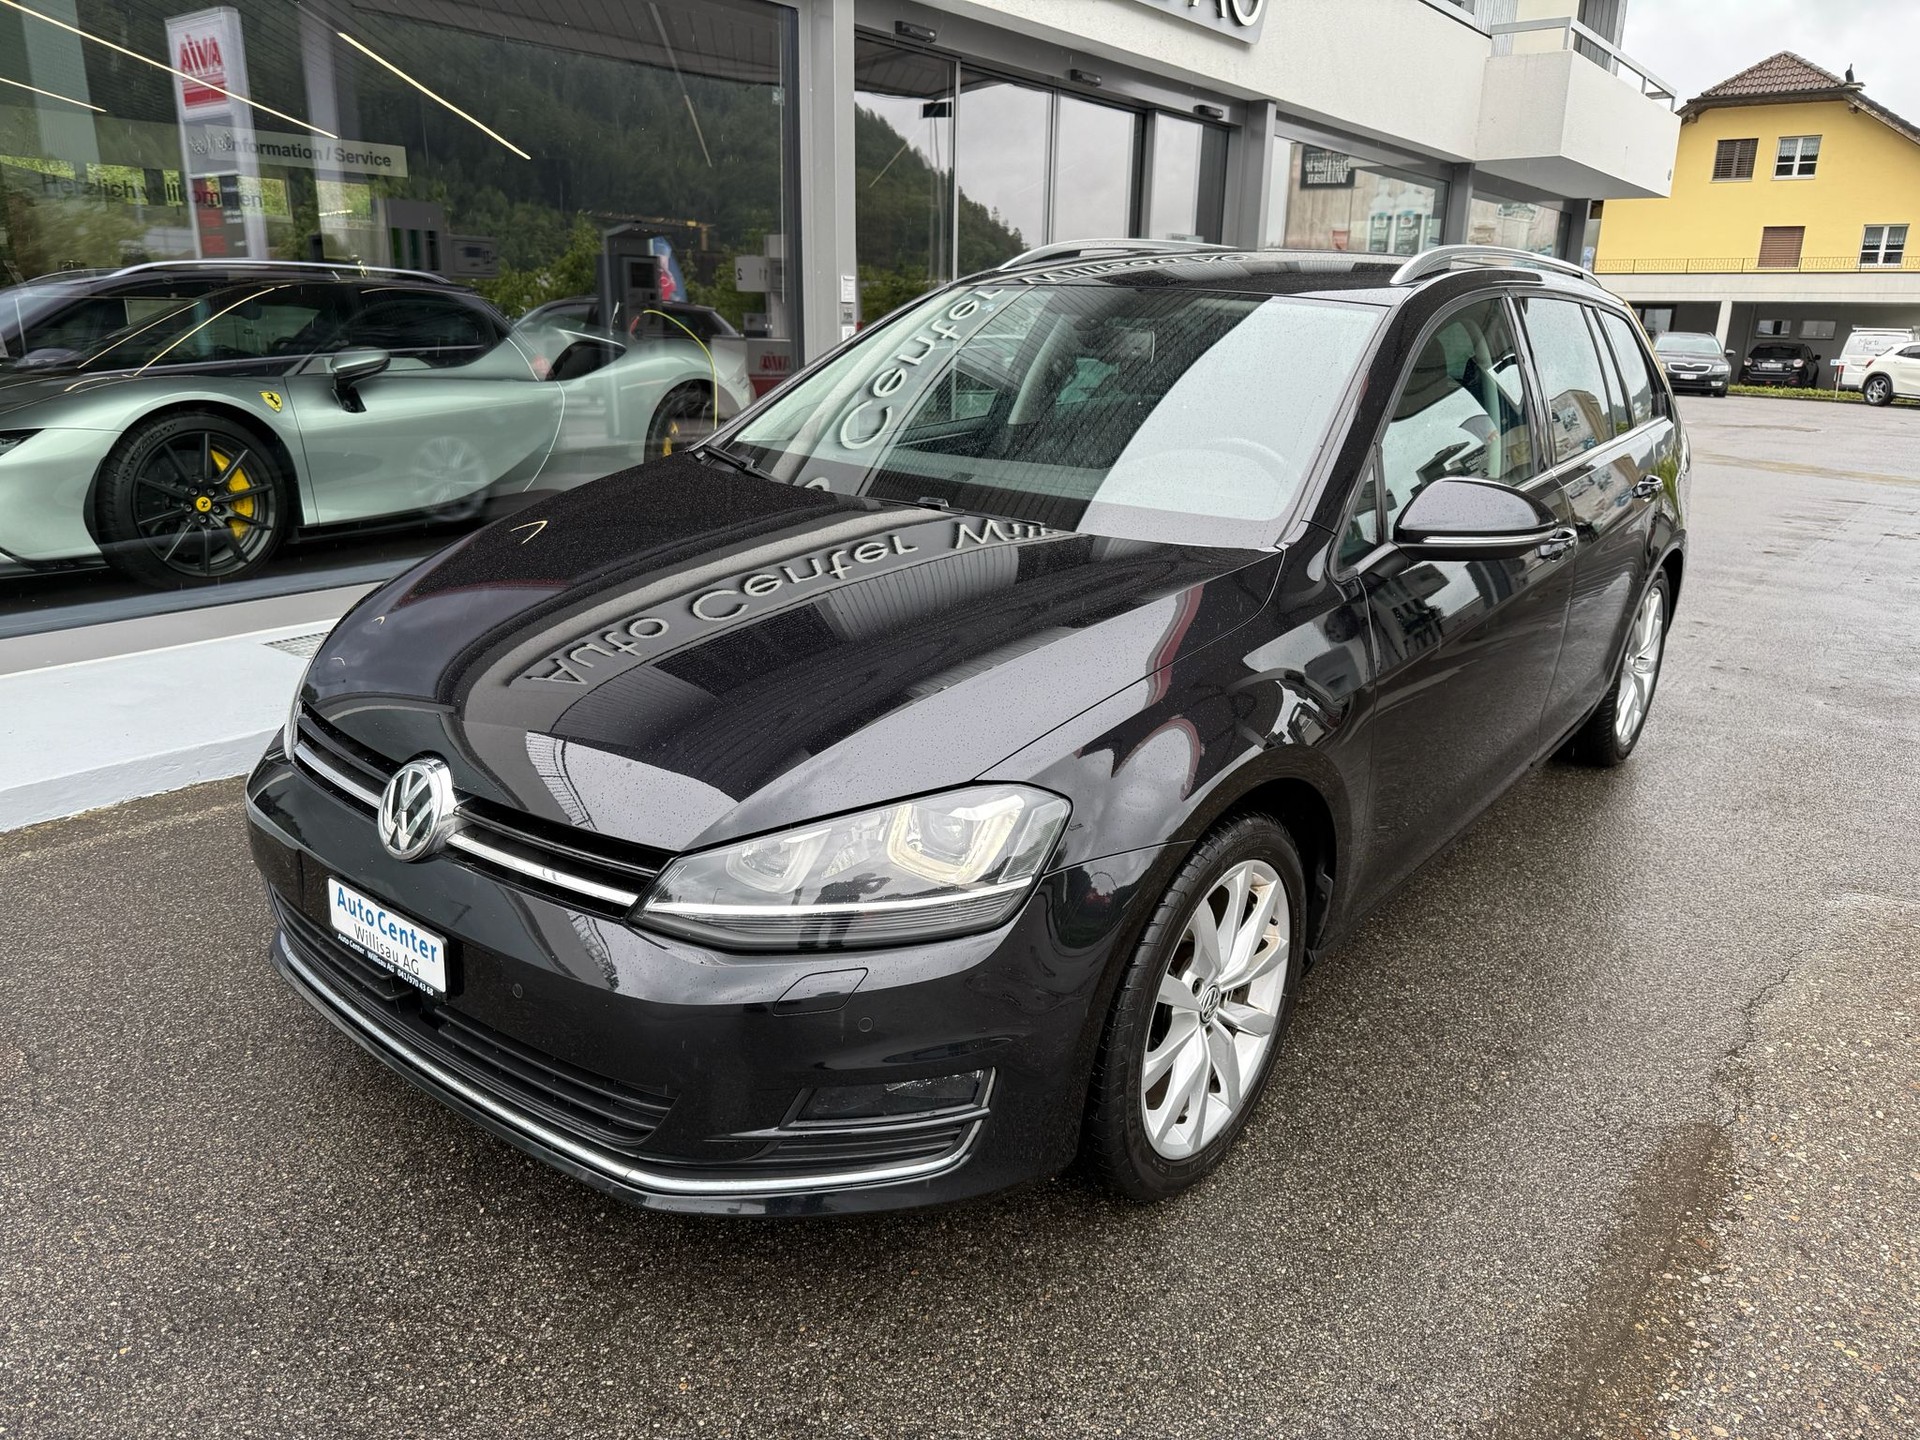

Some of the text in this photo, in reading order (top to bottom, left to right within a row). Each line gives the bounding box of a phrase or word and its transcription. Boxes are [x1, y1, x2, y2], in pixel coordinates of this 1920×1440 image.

[334, 147, 392, 167] Service
[337, 933, 349, 946] Auto
[349, 940, 365, 955] Center
[367, 951, 386, 968] Willisau
[387, 963, 395, 973] AG
[354, 923, 420, 976] Willisau AG
